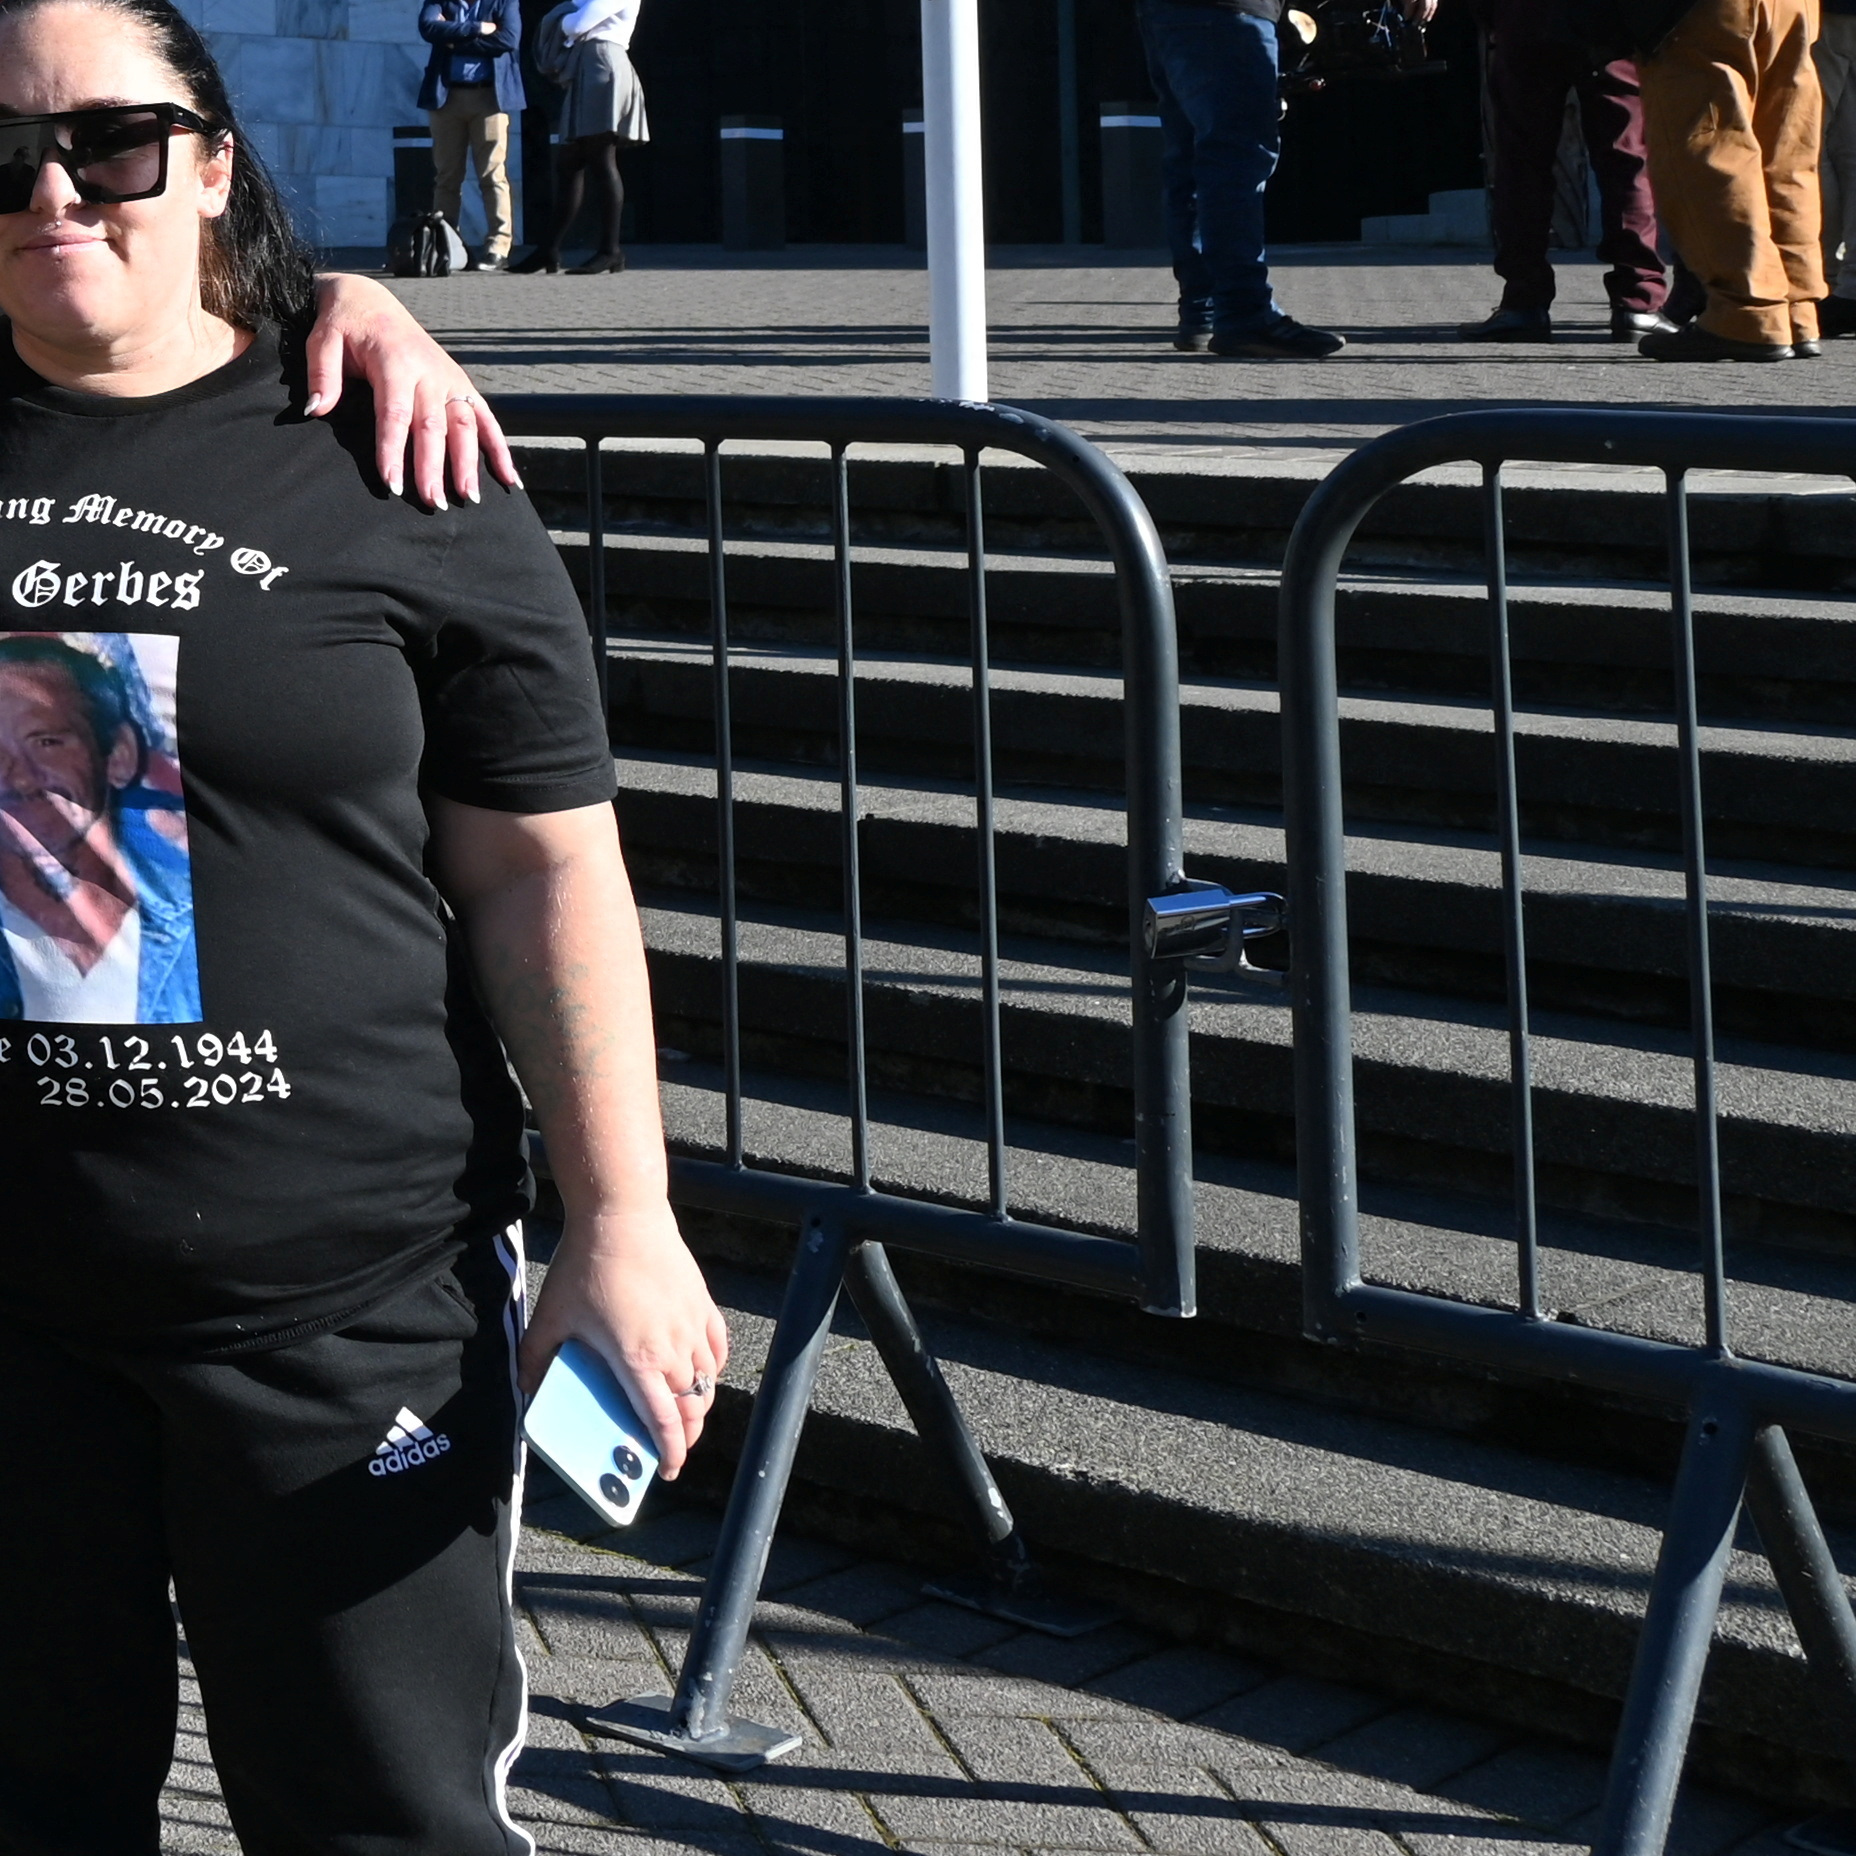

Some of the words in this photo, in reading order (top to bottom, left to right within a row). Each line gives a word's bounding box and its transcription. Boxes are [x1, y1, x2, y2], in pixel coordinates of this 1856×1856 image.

[62, 492, 225, 556] Memory
[230, 547, 289, 592] Of
[11, 559, 205, 610] Gerbes
[27, 1028, 278, 1071] 03.12.1944
[37, 1068, 291, 1109] 28.05.2024
[368, 1433, 451, 1477] adidas
